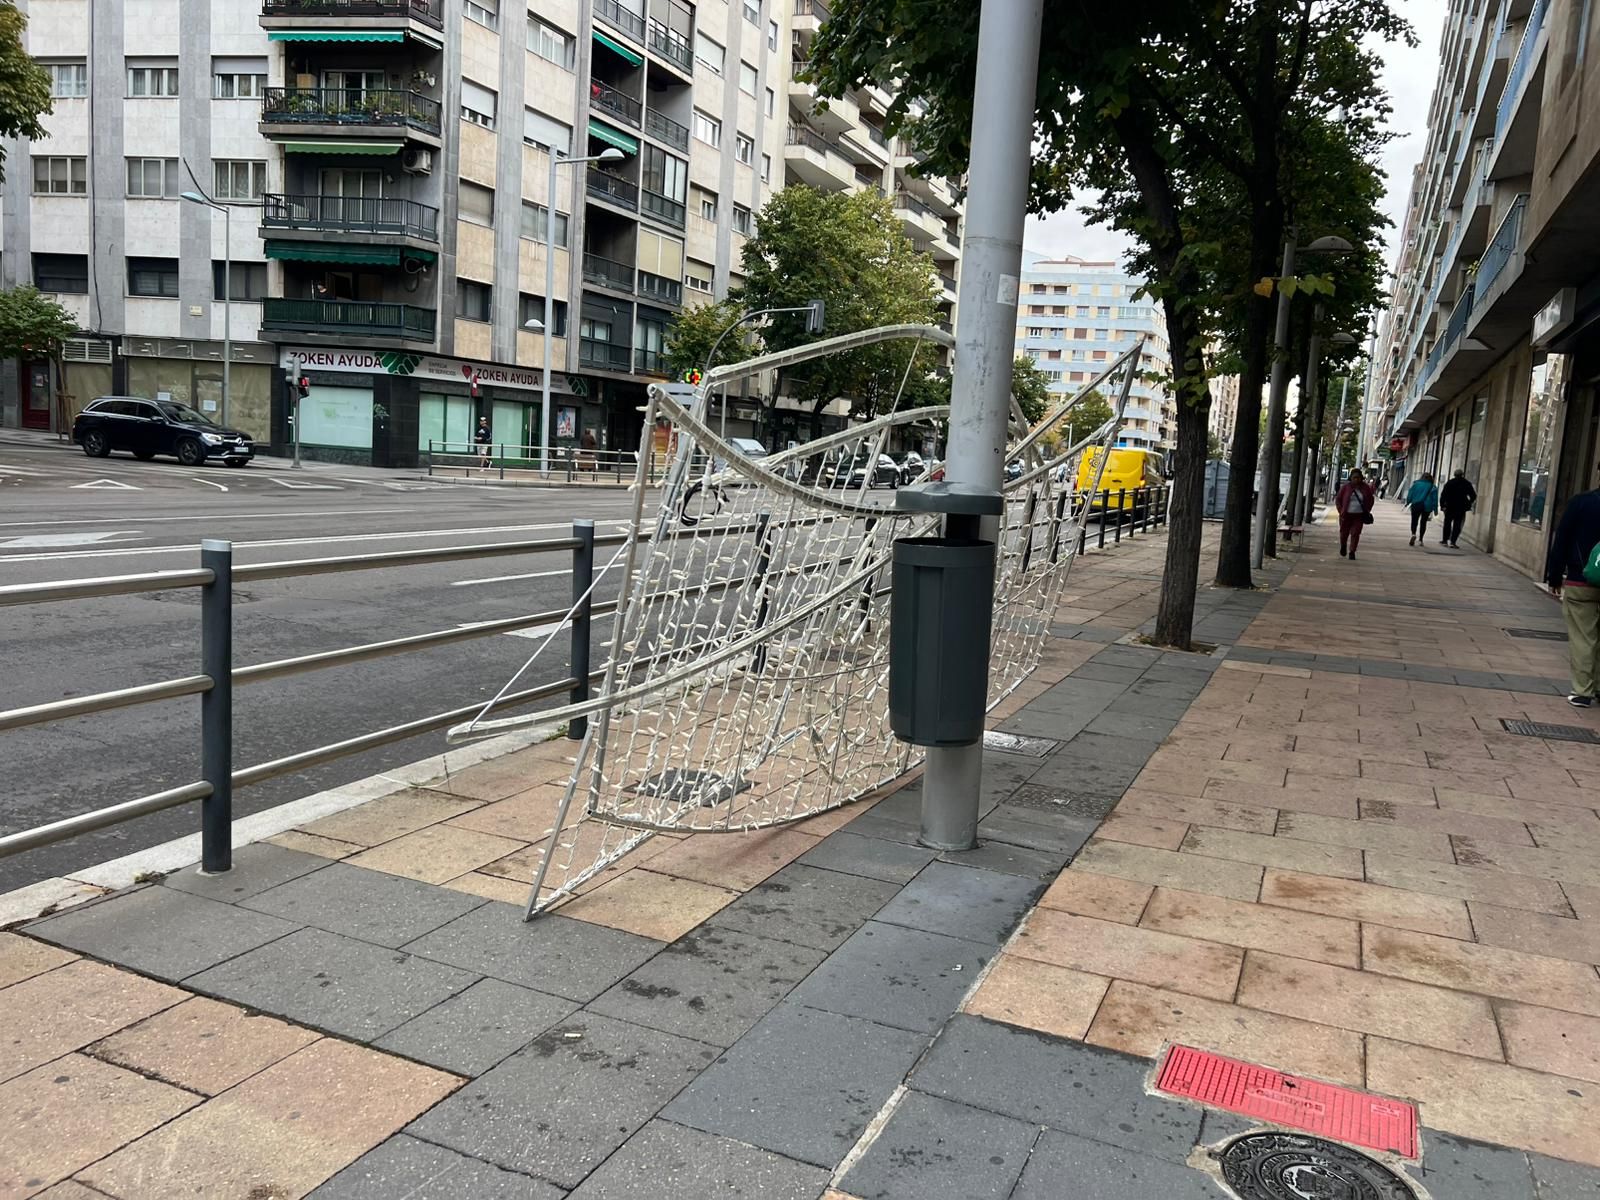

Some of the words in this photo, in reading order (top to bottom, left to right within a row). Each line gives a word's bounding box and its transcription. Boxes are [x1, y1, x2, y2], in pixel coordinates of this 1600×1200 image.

[338, 354, 382, 368] AYUDA
[476, 368, 508, 382] ZOKEN
[510, 374, 539, 386] AYUDA
